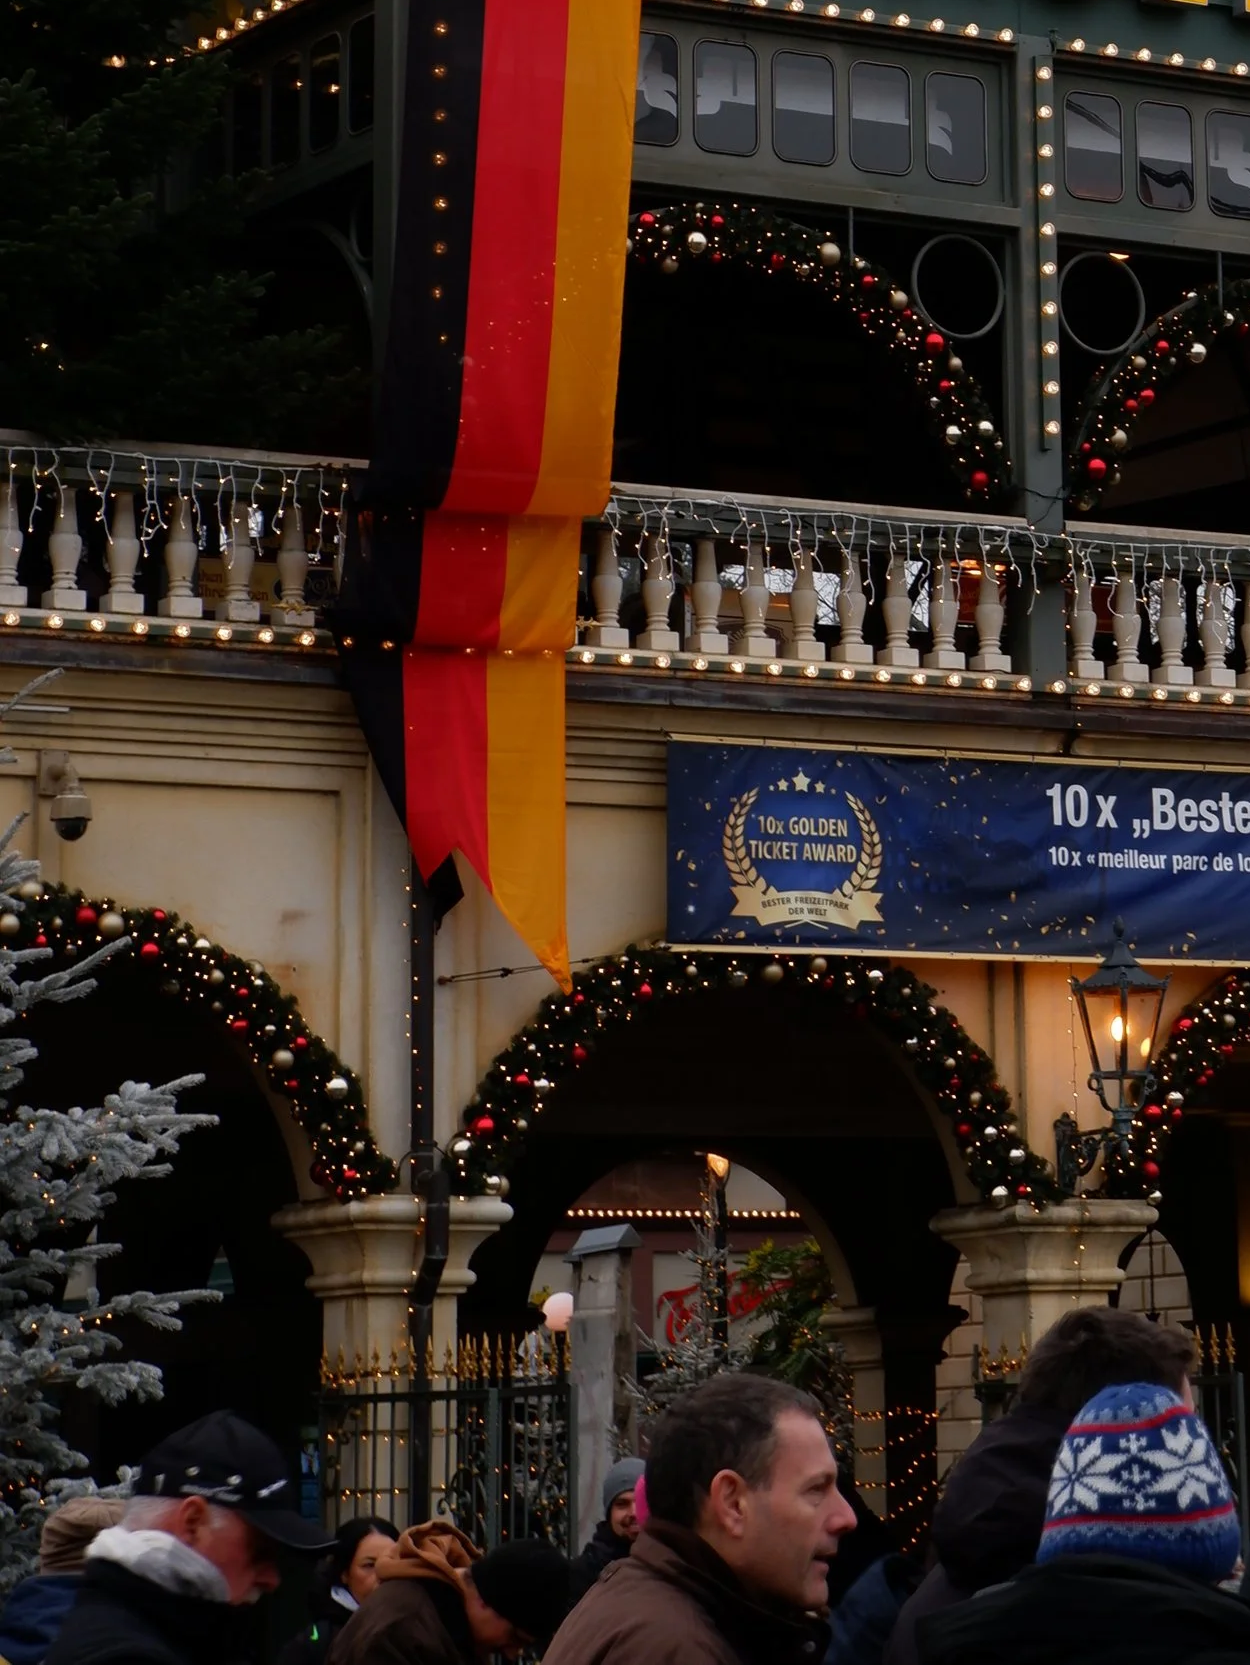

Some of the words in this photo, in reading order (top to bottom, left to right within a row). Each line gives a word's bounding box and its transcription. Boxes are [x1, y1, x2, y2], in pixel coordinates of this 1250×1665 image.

[1045, 783, 1089, 827] 10
[1095, 794, 1118, 828] x
[757, 815, 785, 834] 10x
[789, 816, 848, 837] GOLDEN
[749, 839, 799, 860] TICKET
[802, 842, 857, 863] AWARD
[1048, 846, 1069, 866] 10
[1172, 854, 1209, 874] parc
[1213, 852, 1234, 872] de
[761, 896, 792, 909] BESTER
[795, 896, 849, 911] FREIZEITPARK
[788, 907, 805, 916] DER
[807, 907, 828, 917] WELT
